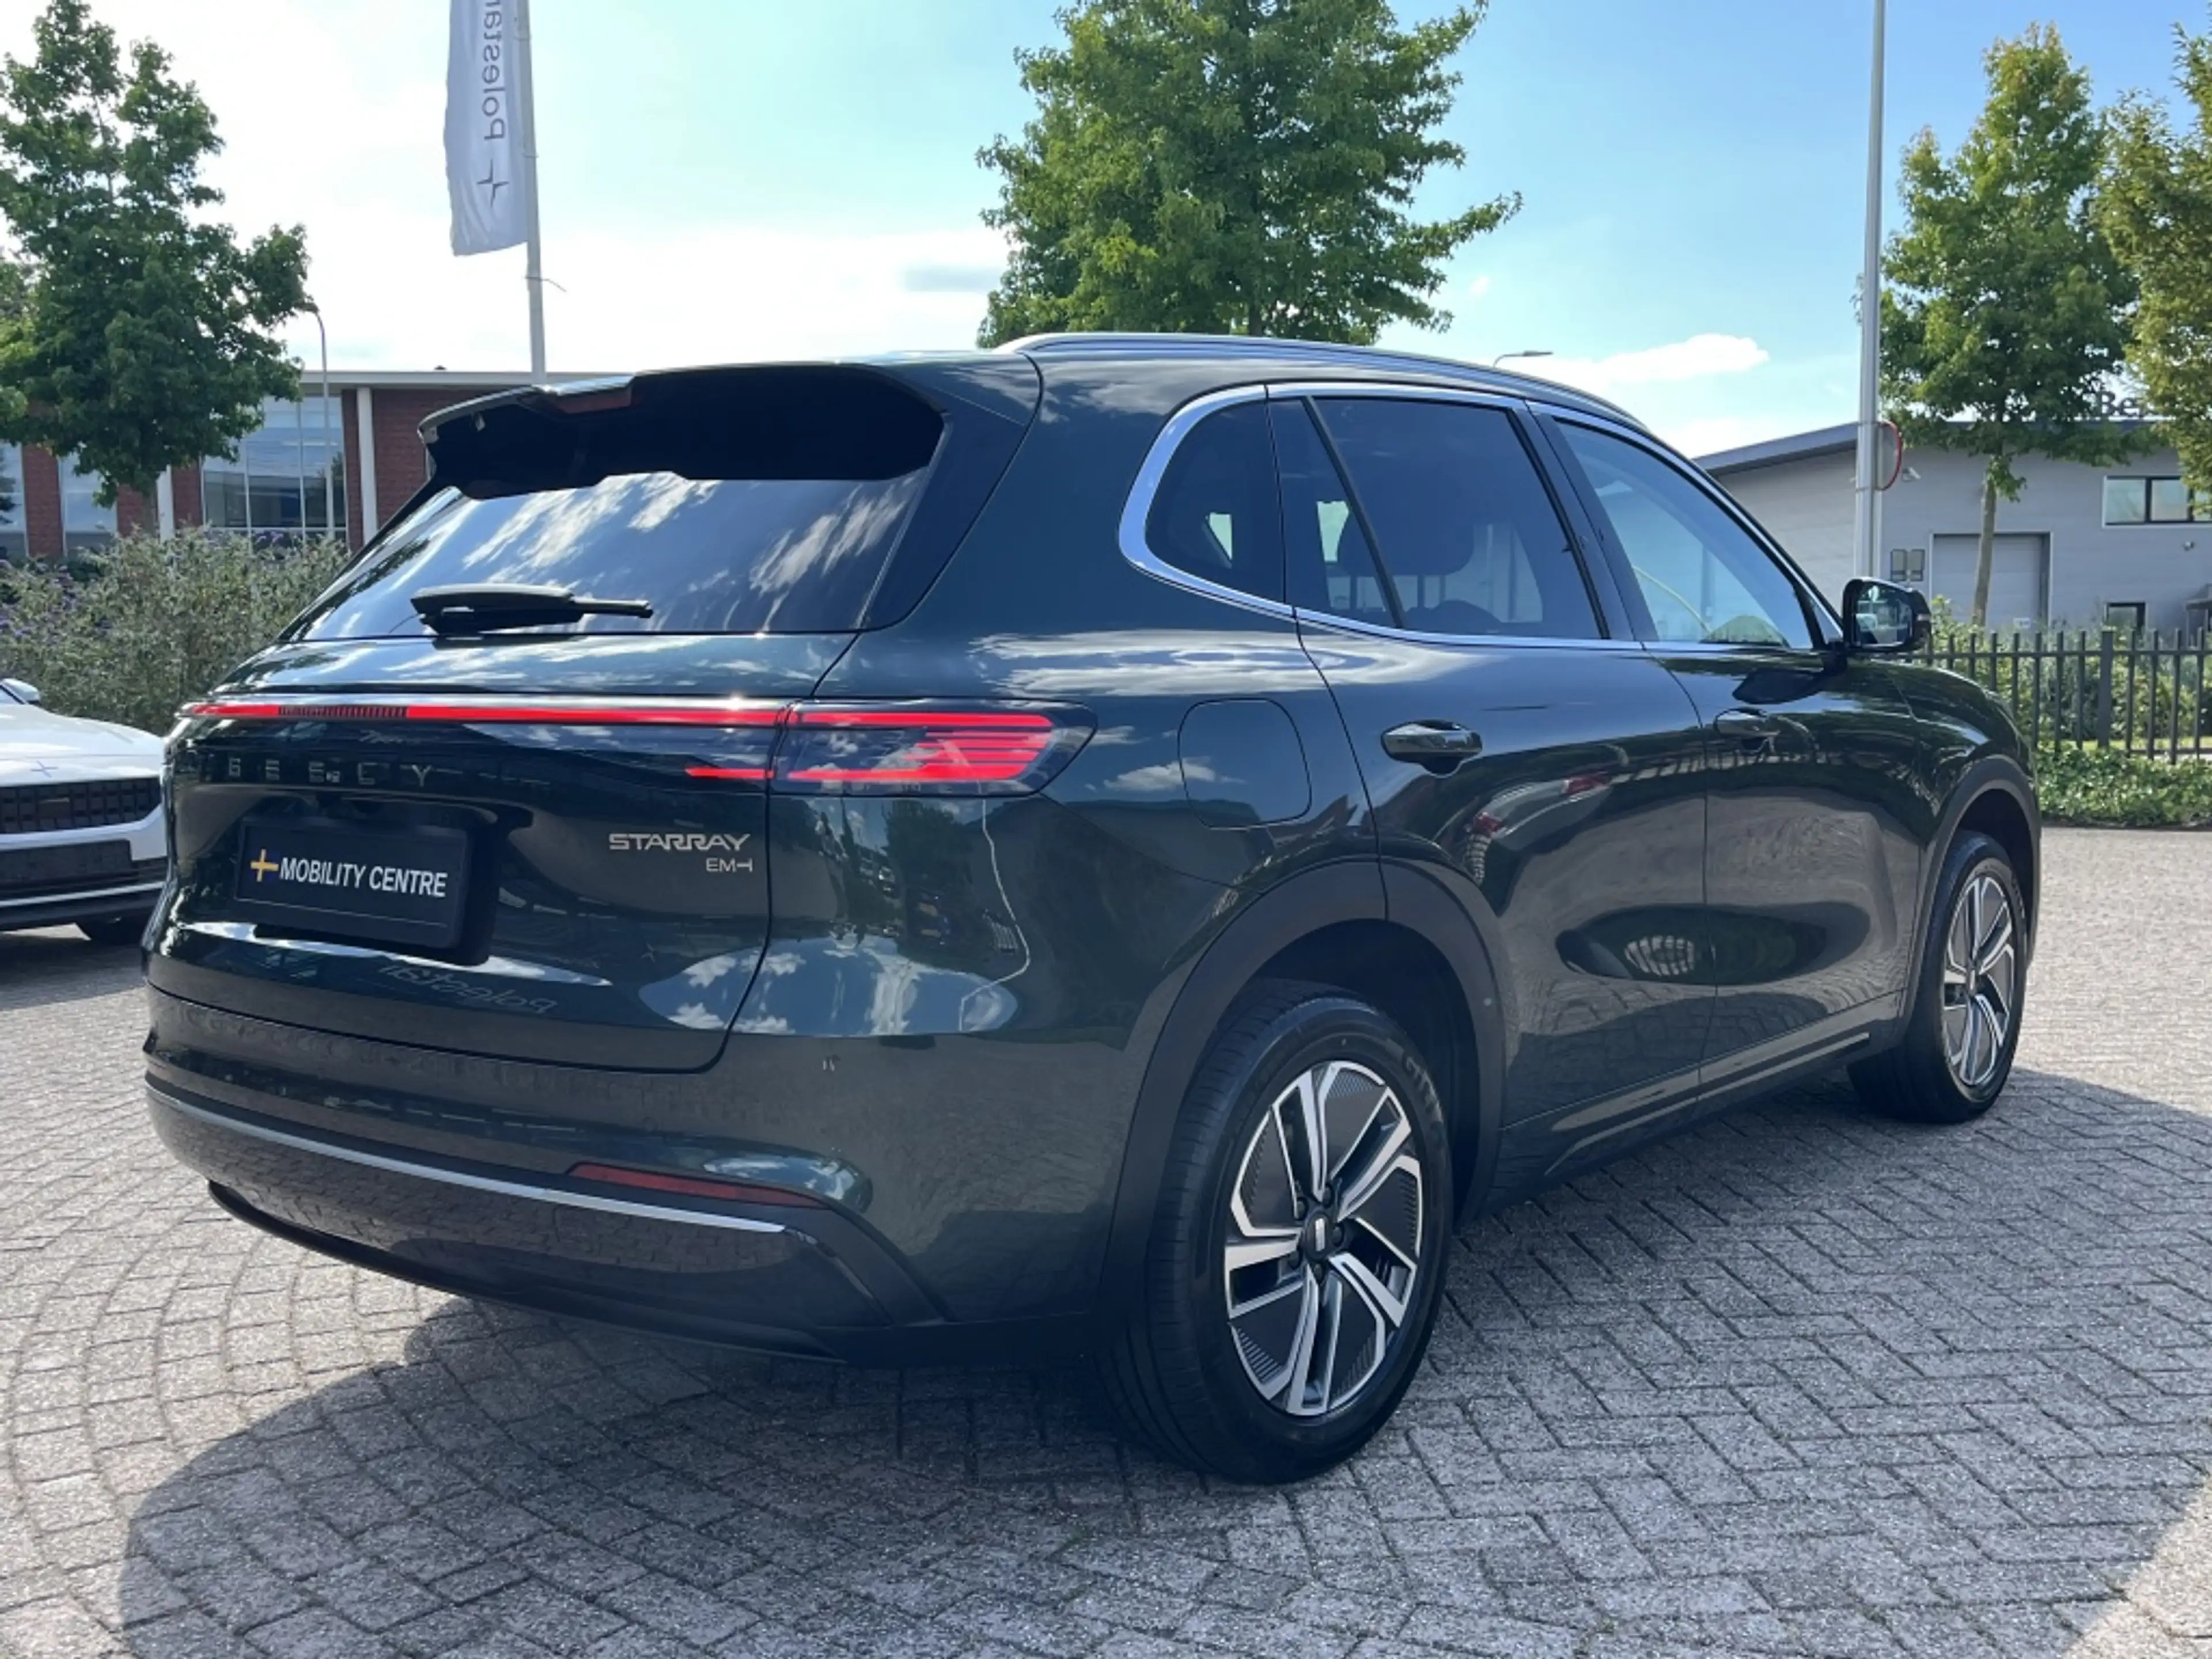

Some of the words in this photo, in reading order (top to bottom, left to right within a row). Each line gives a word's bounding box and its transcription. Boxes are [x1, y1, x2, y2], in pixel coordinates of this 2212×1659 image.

[608, 833, 751, 851] STARRAY
[280, 857, 366, 888] MOBILITY
[369, 866, 448, 897] CENTRE
